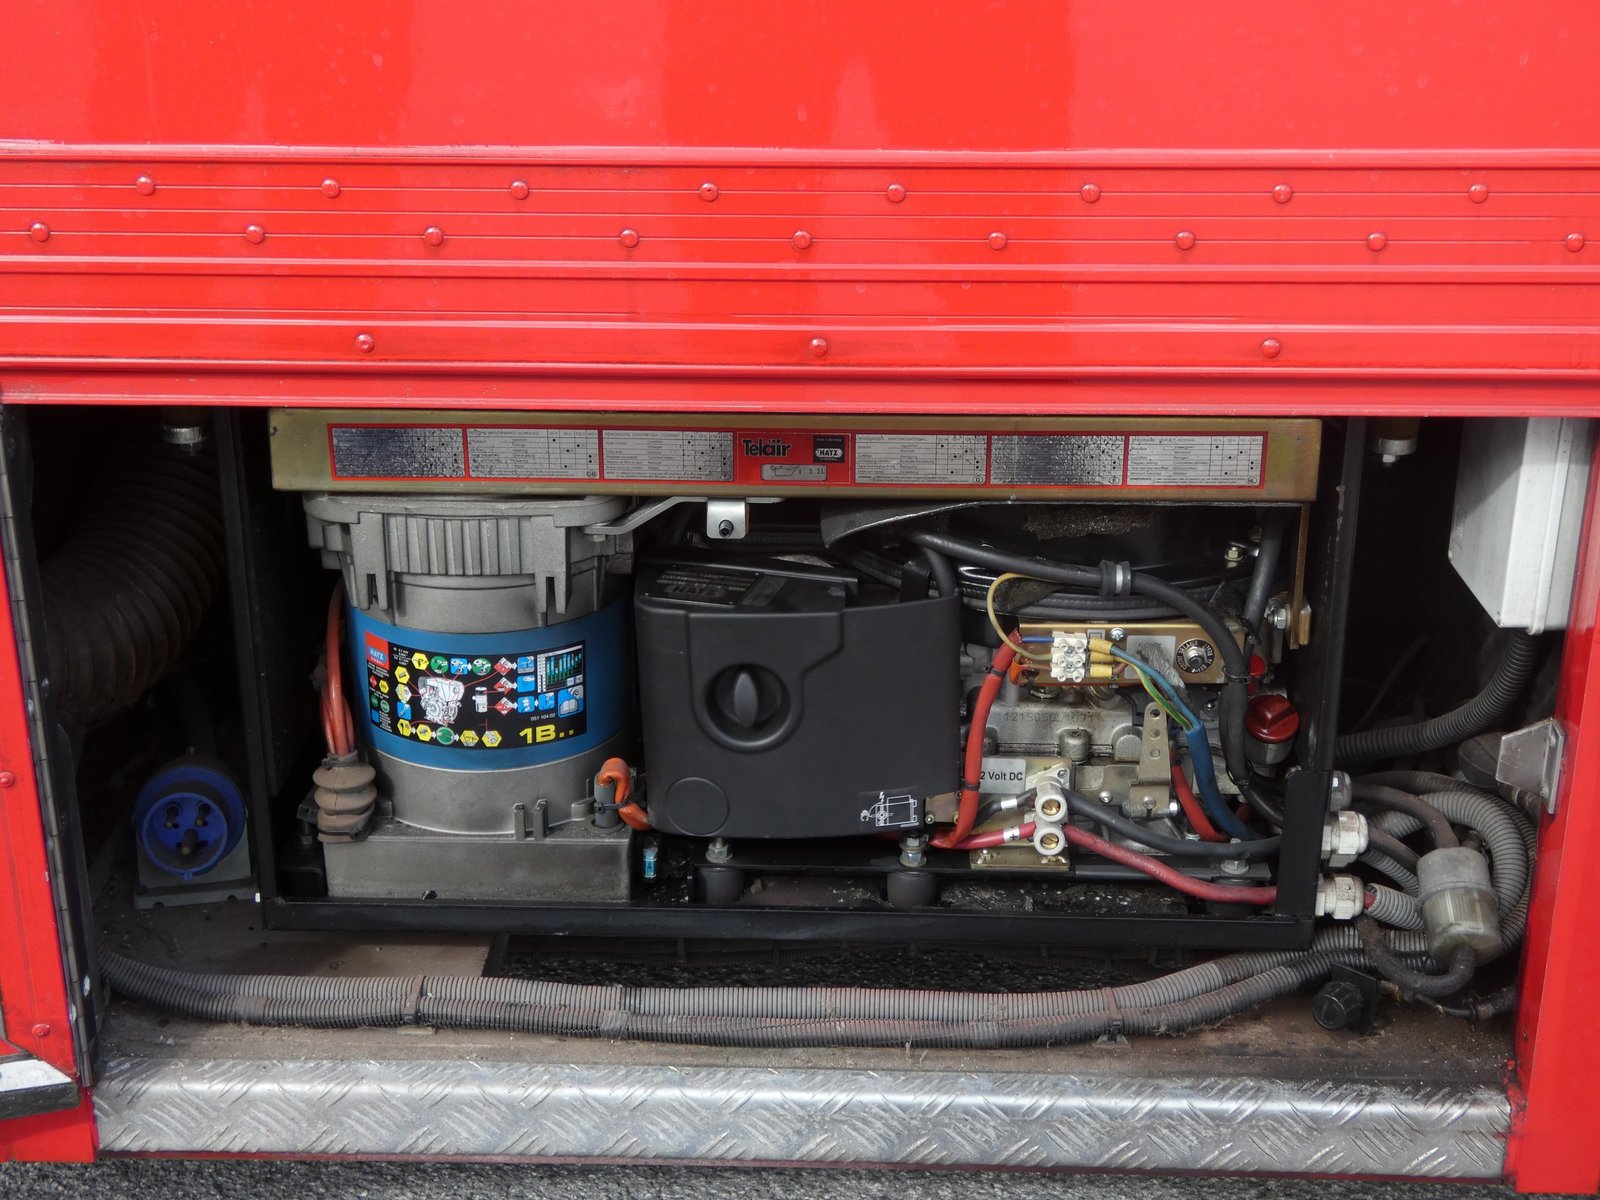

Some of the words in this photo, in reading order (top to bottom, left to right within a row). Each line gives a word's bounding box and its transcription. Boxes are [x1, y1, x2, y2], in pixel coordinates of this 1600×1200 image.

[369, 647, 385, 661] HATZ
[988, 771, 1006, 781] Volt
[1009, 772, 1023, 781] DC
